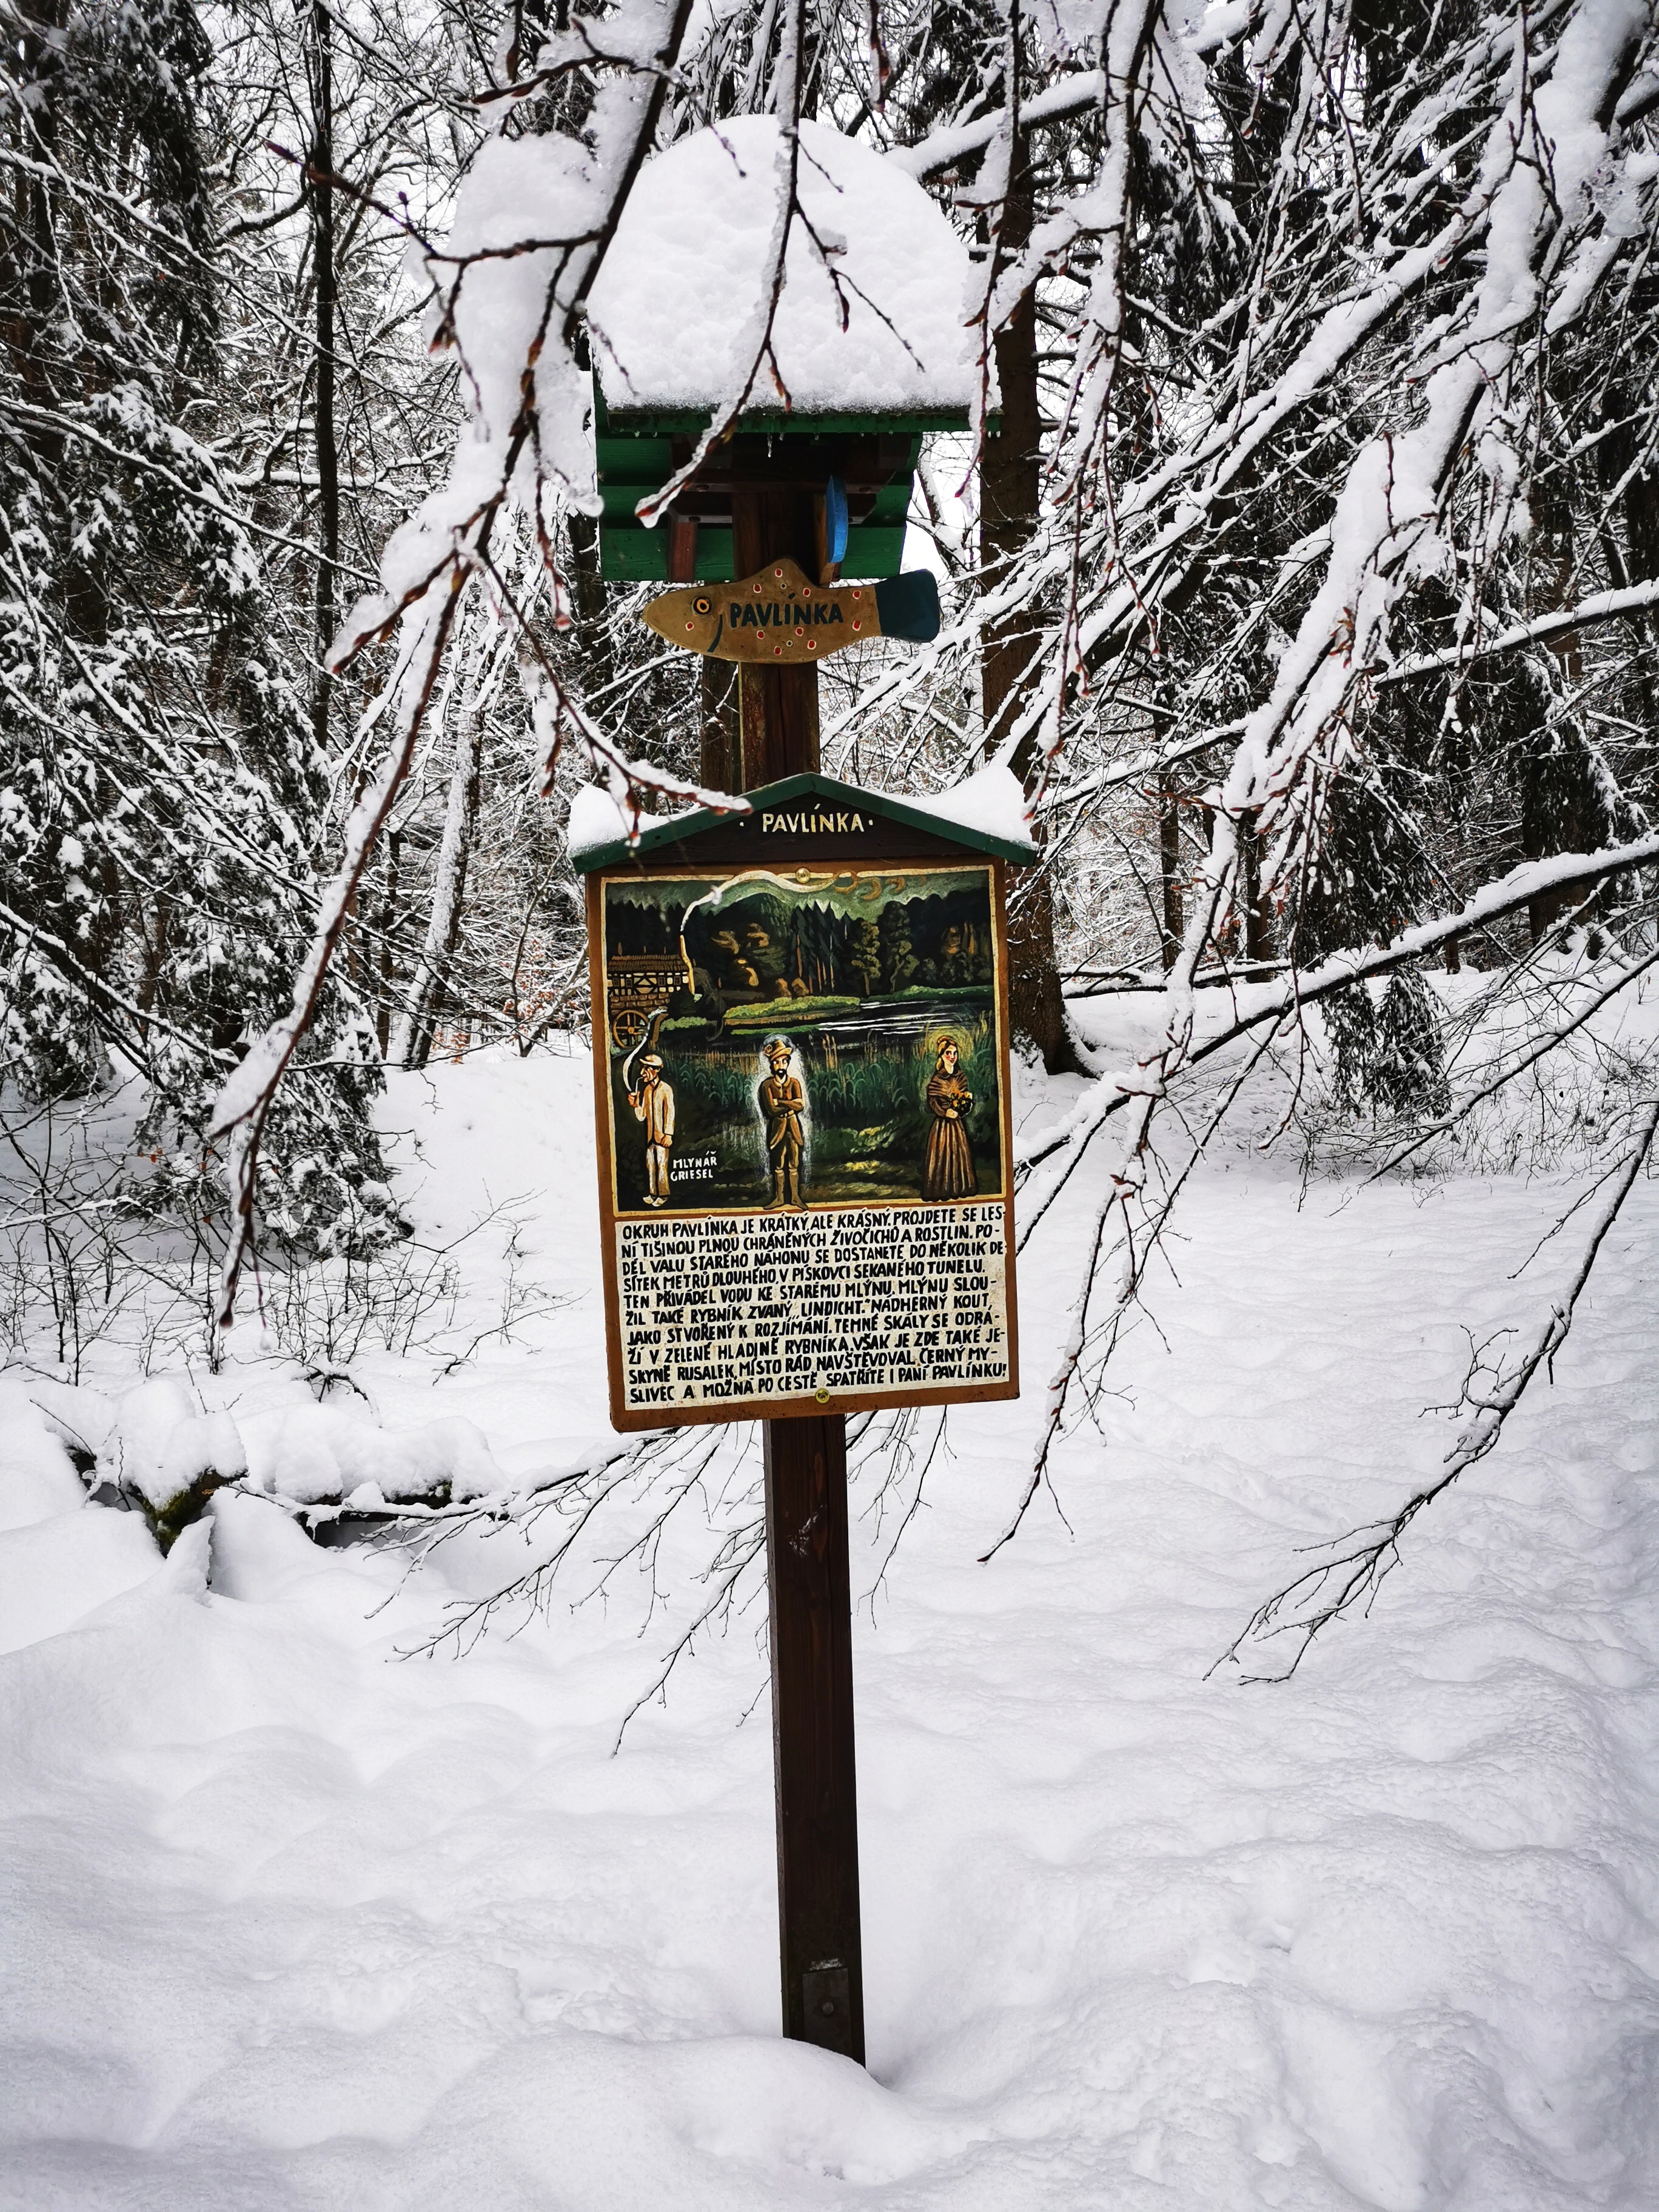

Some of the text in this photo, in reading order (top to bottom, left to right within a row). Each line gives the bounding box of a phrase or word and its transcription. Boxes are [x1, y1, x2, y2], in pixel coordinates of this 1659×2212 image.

[730, 592, 843, 628] PAVLÍNKA
[762, 803, 864, 833] PAVLÍNKA
[671, 1169, 713, 1182] GRIESEL
[673, 1150, 717, 1168] MLYNÁŘ
[623, 1224, 669, 1240] OKRUH
[672, 1216, 738, 1237] PAVLÍNKA
[741, 1219, 754, 1234] JE
[810, 1214, 833, 1230] ALE
[837, 1209, 891, 1228] KRÁSNÝ.
[893, 1208, 956, 1225] PROJDETE
[962, 1208, 977, 1221] SE
[622, 1241, 638, 1258] NÍ
[641, 1241, 695, 1257] TIŠINOU
[699, 1238, 739, 1253] PLNOU
[743, 1231, 826, 1250] CHRÁNĚNÝCH
[830, 1227, 899, 1245] ŽIVOČICHŮ
[901, 1228, 912, 1242] A
[915, 1225, 973, 1241] ROSTLIN.
[623, 1259, 646, 1276] DÉL
[651, 1259, 685, 1273] VALU
[690, 1251, 748, 1270] STARÉHO
[754, 1250, 809, 1267] NÁHONU
[816, 1249, 829, 1263] SE
[834, 1245, 904, 1262] DOSTANETE
[910, 1244, 926, 1258] DO
[929, 1241, 987, 1258] NĚKOLIK
[623, 1259, 985, 1292] SÍTEK METRŮ DLOUHÉHO, V PÍSKOVCI SEKANÉHO TUNELU.
[624, 1295, 649, 1309] TEN
[720, 1288, 752, 1303] VODU
[758, 1286, 773, 1301] KE
[780, 1282, 840, 1298] STARÉMU
[899, 1276, 948, 1295] MLÝNU
[626, 1311, 646, 1326] ŽIL
[652, 1307, 683, 1324] TAKÉ
[691, 1306, 742, 1323] RYBNÍK
[748, 1301, 793, 1319] ZVANÝ
[871, 1293, 948, 1313] NÁDHERNÝ
[627, 1330, 661, 1346] JAKO
[667, 1323, 735, 1343] STVOŘENÝ
[739, 1325, 748, 1338] K
[755, 1316, 832, 1334] ROZJÍMÁNÍ.
[835, 1314, 878, 1333] TEMNÉ
[883, 1313, 929, 1330] SKÁLY
[932, 1313, 948, 1327] SE
[628, 1347, 642, 1364] ŽÍ
[649, 1349, 659, 1365] V
[665, 1344, 711, 1363] ZELENÉ
[718, 1338, 779, 1359] HLADINĚ
[853, 1333, 890, 1350] VŠAK
[894, 1333, 909, 1348] JE
[914, 1331, 939, 1346] ZDE
[947, 1326, 980, 1344] TAKÉ
[629, 1365, 671, 1384] SKYNĚ
[739, 1357, 782, 1376] MÍSTO
[785, 1355, 811, 1373] RÁD
[817, 1350, 915, 1370] NAVŠTĚVOVAL
[919, 1346, 965, 1364] ČERNÝ
[630, 1361, 1007, 1403] SLIVEC A MOŽNÁ PO CESTĚ SPATŘÍTE I PANÍ PAVLÍNKU!
